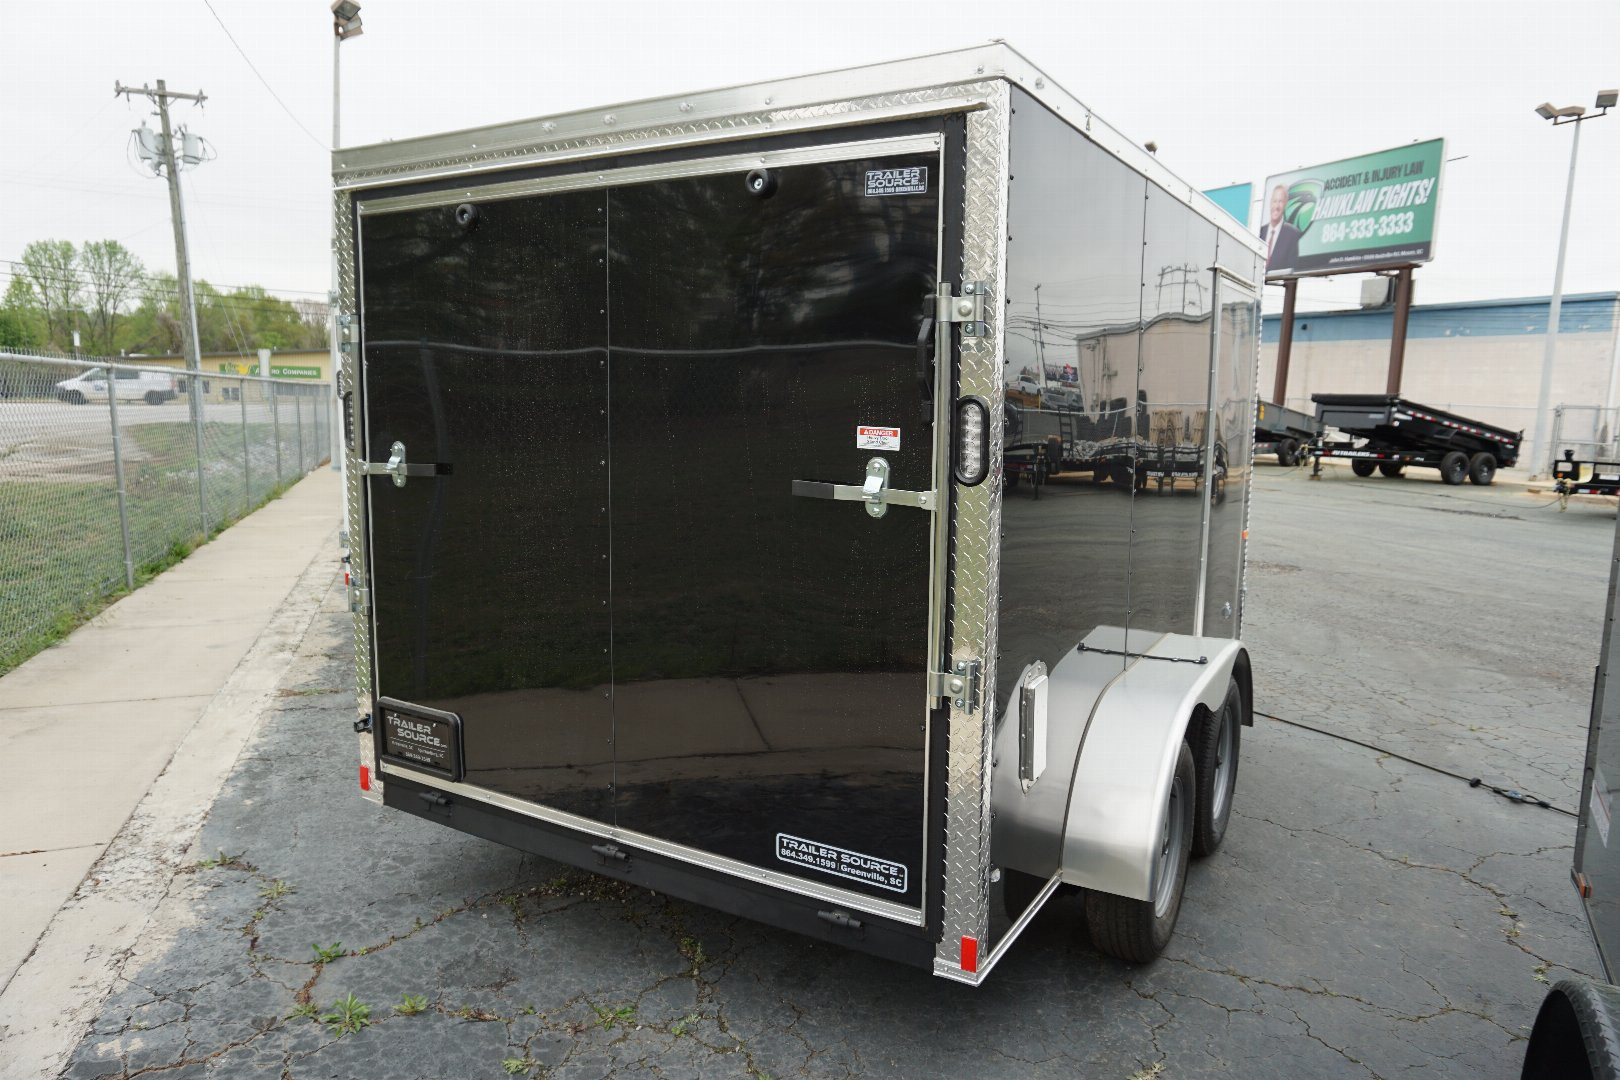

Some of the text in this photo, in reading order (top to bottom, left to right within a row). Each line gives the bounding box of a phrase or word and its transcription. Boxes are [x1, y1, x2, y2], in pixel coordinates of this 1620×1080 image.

[867, 170, 920, 180] TRAILER
[868, 177, 919, 188] SOURCE
[1323, 160, 1425, 191] ACCIDENT & INJURY LAW
[1311, 177, 1435, 220] HAWKLAW FIGHTS!
[1321, 211, 1415, 243] 864-333-3333
[868, 429, 894, 437] DANGER
[387, 716, 431, 734] TRAILER
[397, 728, 440, 746] SOURCE
[781, 838, 898, 876] TRAILER SOURCE
[781, 848, 902, 887] 864.349.1599 Greenville, SC
